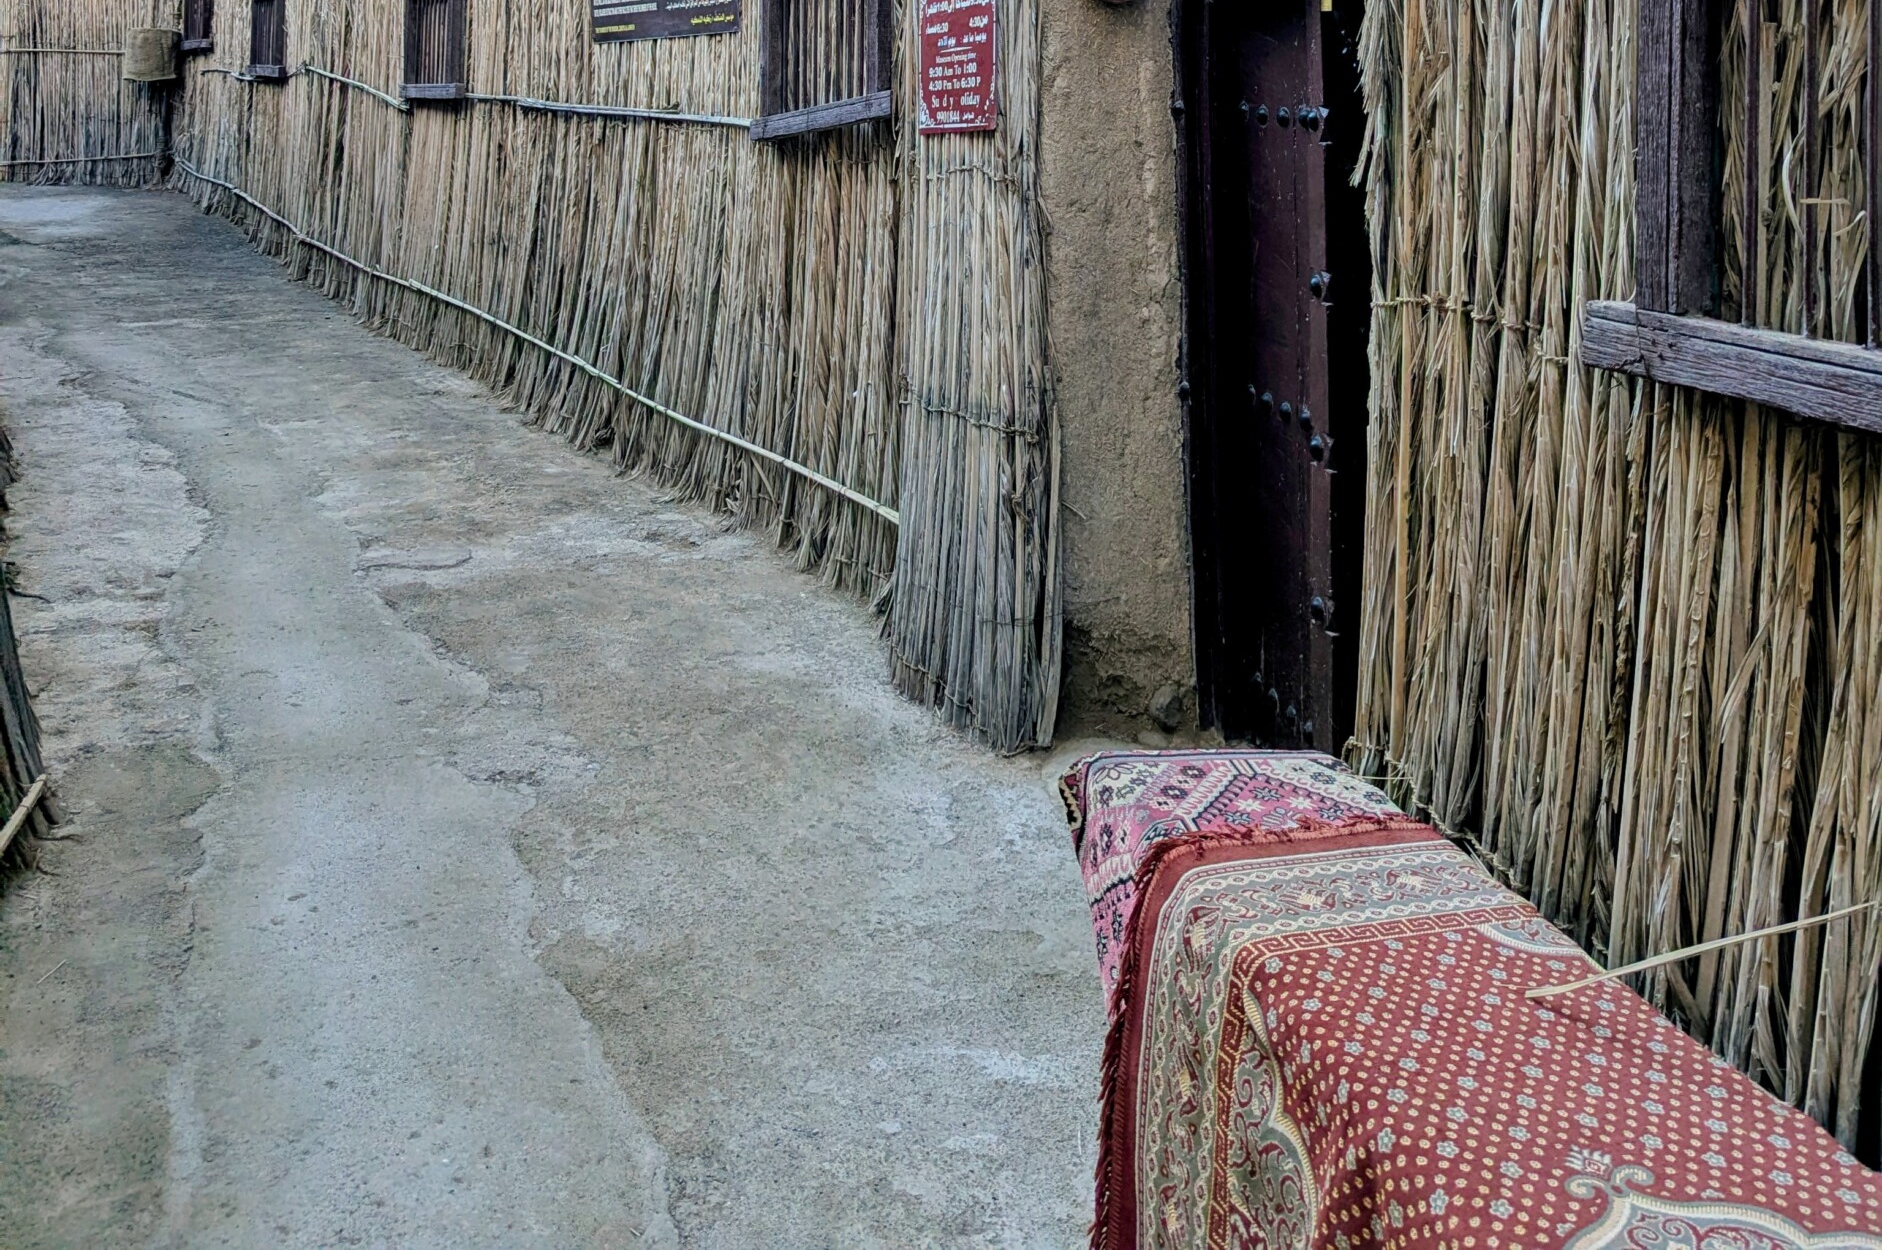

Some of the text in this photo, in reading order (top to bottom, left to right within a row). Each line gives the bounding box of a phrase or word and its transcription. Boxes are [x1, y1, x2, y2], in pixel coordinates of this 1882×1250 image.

[928, 62, 977, 78] 9:30 Am To 1:00
[928, 80, 943, 91] 4:30
[943, 80, 952, 90] Pm
[952, 78, 960, 89] To
[960, 77, 976, 88] 6:30
[960, 91, 980, 108] oliday
